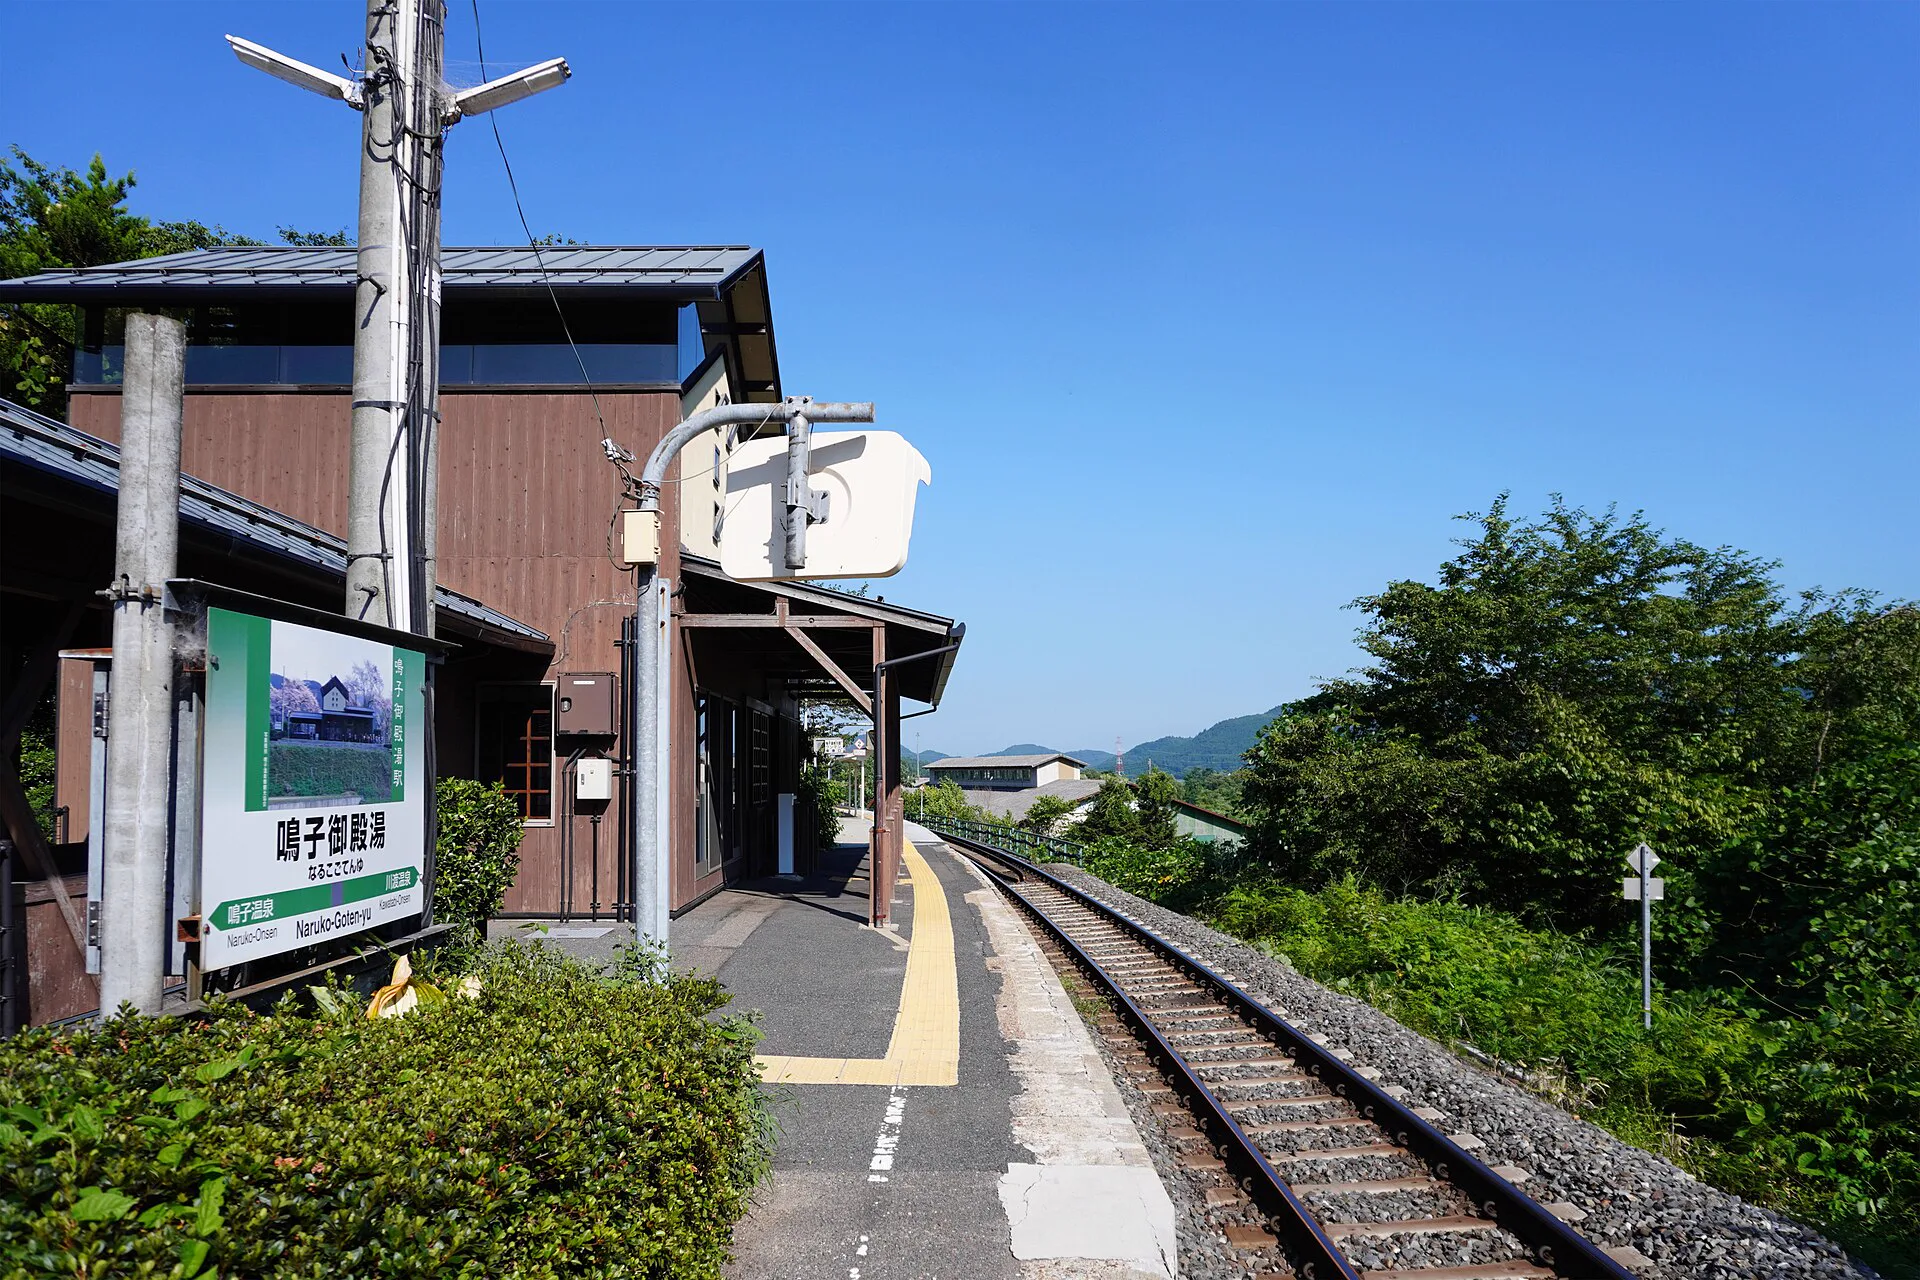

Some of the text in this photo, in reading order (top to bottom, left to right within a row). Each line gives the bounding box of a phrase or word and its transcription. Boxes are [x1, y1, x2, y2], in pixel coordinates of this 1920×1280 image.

[394, 657, 404, 787] 鳴子御殿湯駅
[276, 811, 386, 862] 鳴子御殿湯
[308, 857, 364, 881] なるこごてんゆ
[385, 870, 412, 891] 川渡温泉
[227, 898, 274, 925] 鳴子温泉
[379, 893, 411, 911] Kawatabi-Onsen
[296, 907, 372, 939] Naruko-Goten-yu
[227, 926, 278, 948] Naruko-Onsen
